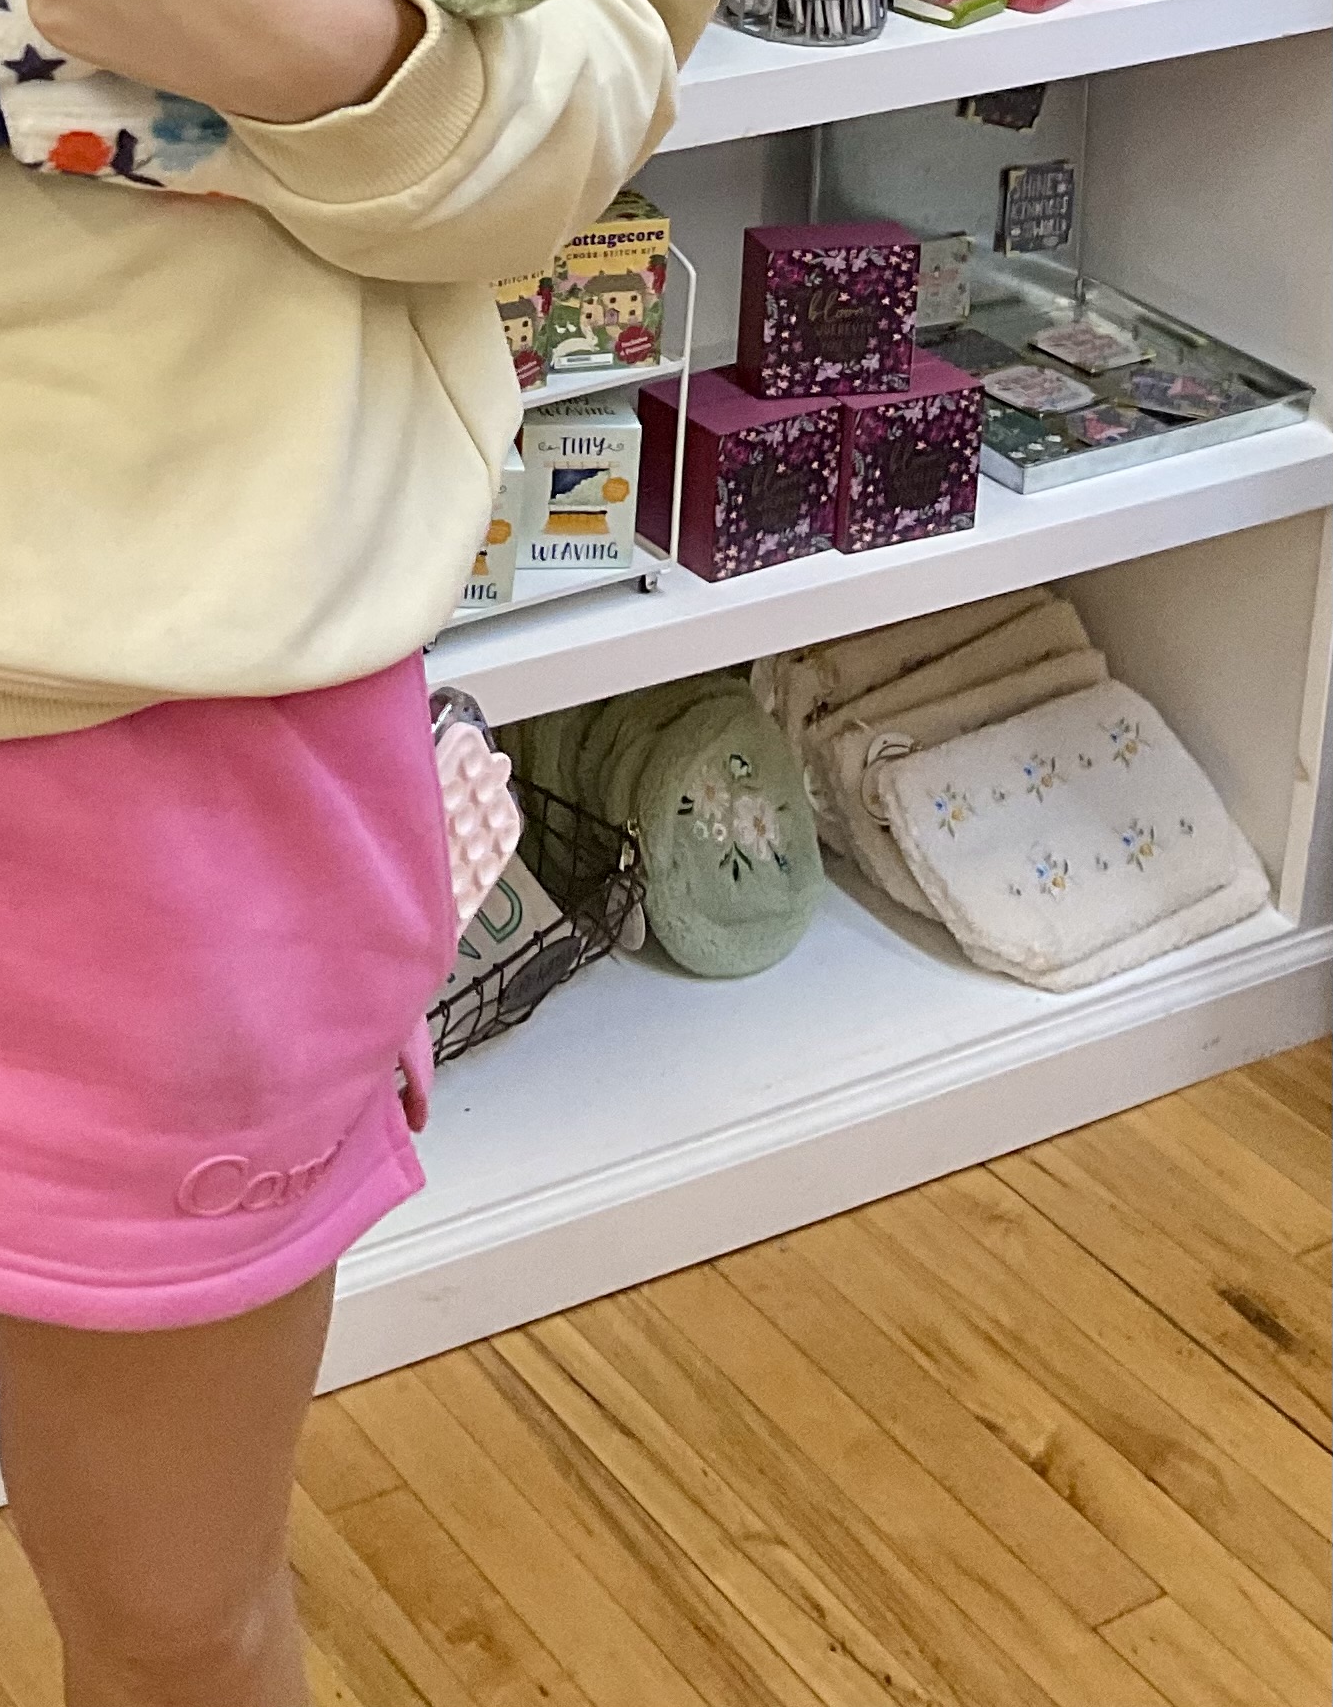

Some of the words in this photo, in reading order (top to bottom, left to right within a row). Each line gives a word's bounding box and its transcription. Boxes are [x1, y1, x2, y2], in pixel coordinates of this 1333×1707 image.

[565, 230, 665, 249] ottagecore
[641, 246, 658, 256] KIT
[531, 270, 546, 280] KIT
[536, 405, 618, 417] WEAVING
[559, 436, 607, 457] TINY
[531, 542, 619, 562] WEAVING
